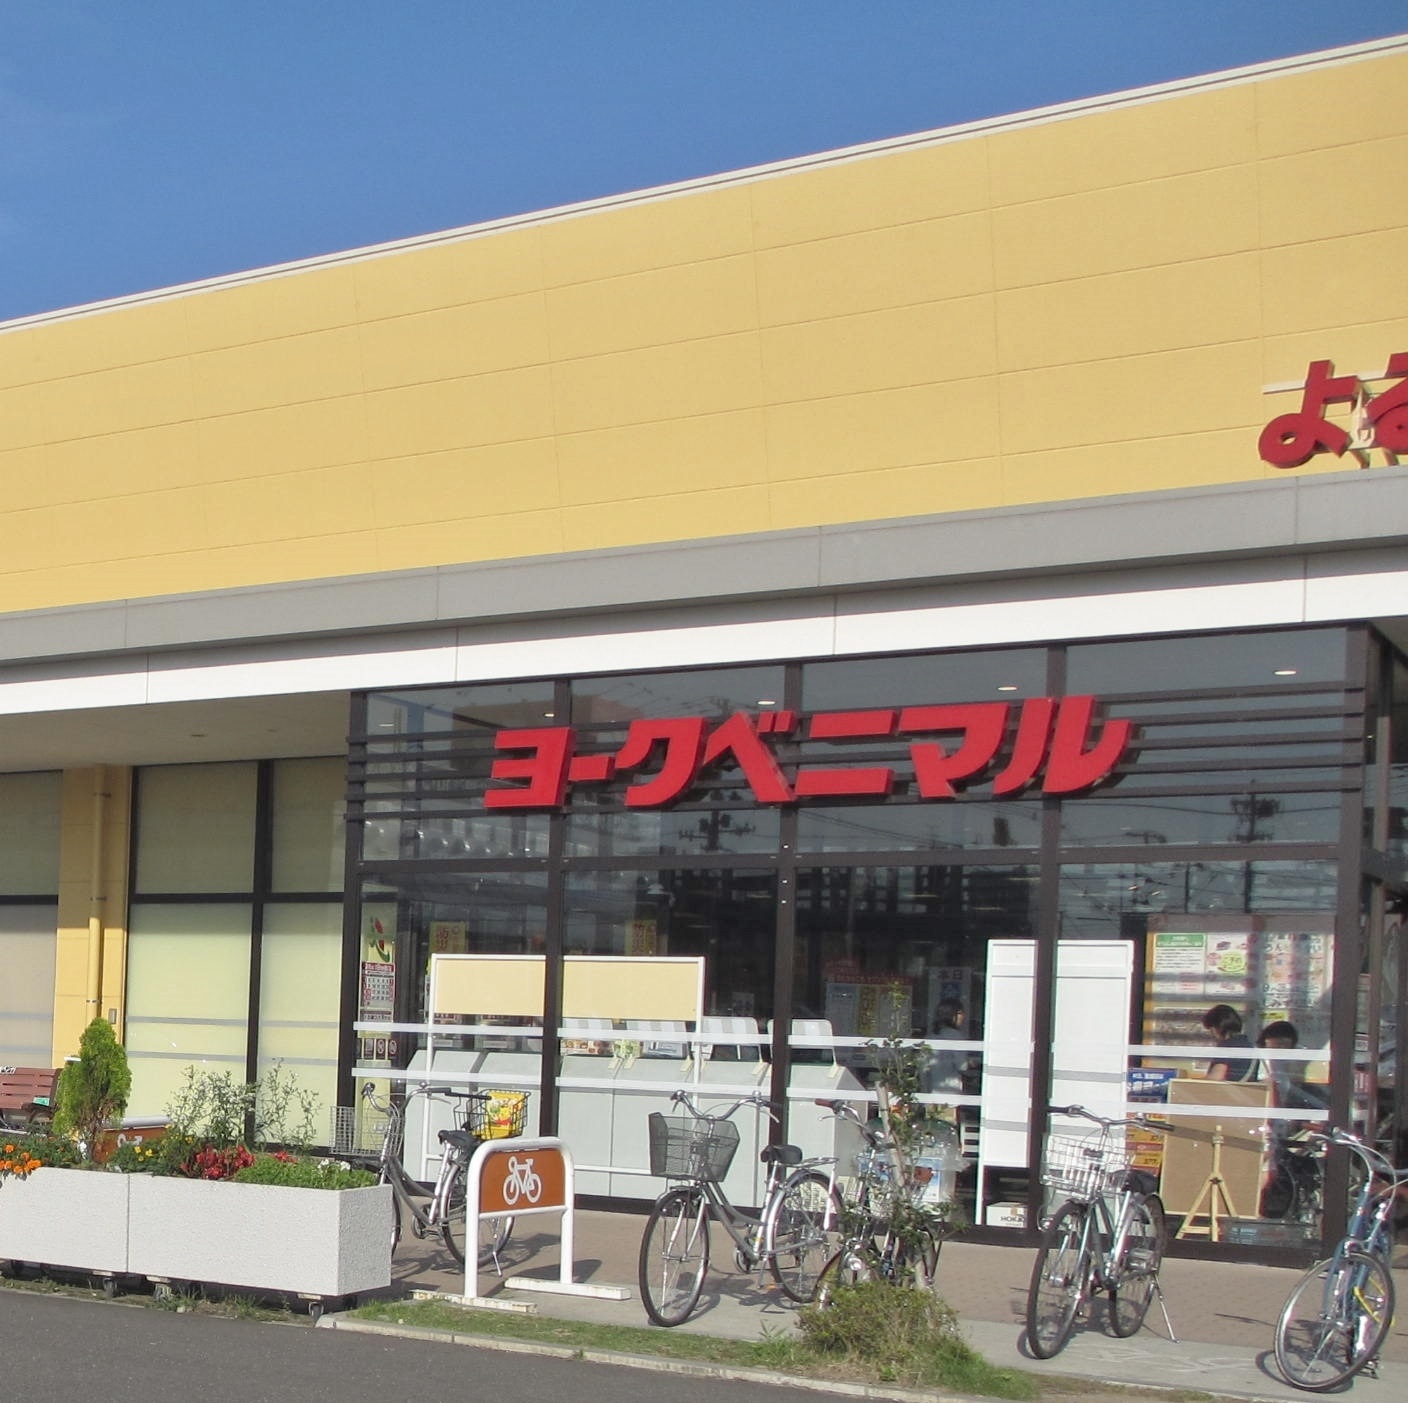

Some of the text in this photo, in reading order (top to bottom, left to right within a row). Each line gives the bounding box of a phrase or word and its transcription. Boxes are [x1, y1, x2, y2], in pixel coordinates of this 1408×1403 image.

[484, 695, 1134, 809] ヨークベニマル
